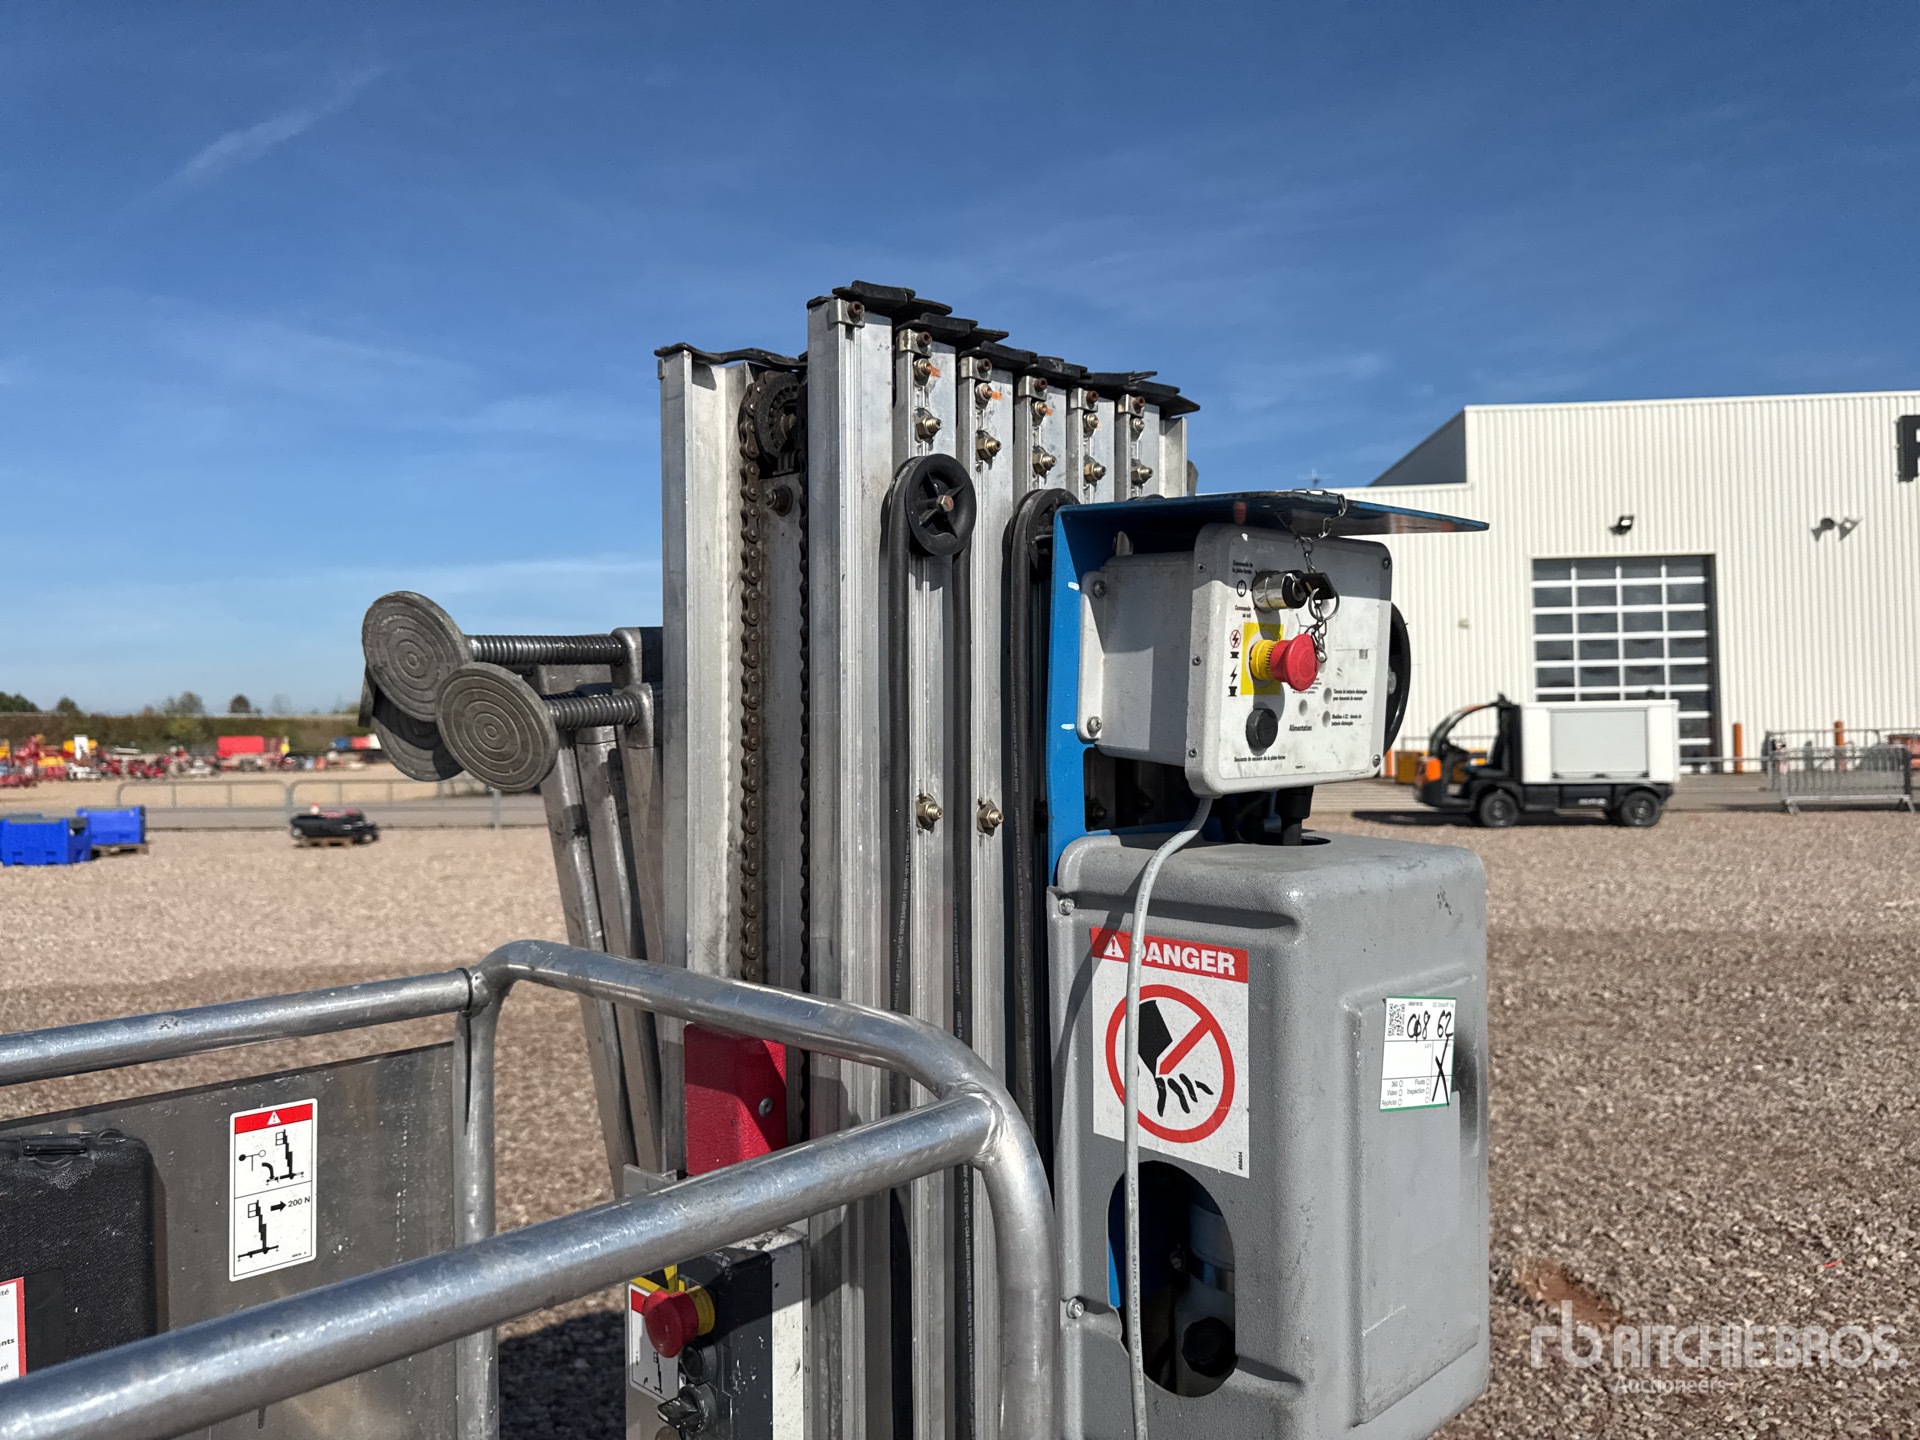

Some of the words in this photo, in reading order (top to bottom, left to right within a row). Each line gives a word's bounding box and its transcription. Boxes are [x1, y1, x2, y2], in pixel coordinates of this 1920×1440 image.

[1289, 724, 1312, 732] Alimentation
[287, 1198, 303, 1208] 200
[304, 1196, 311, 1204] N
